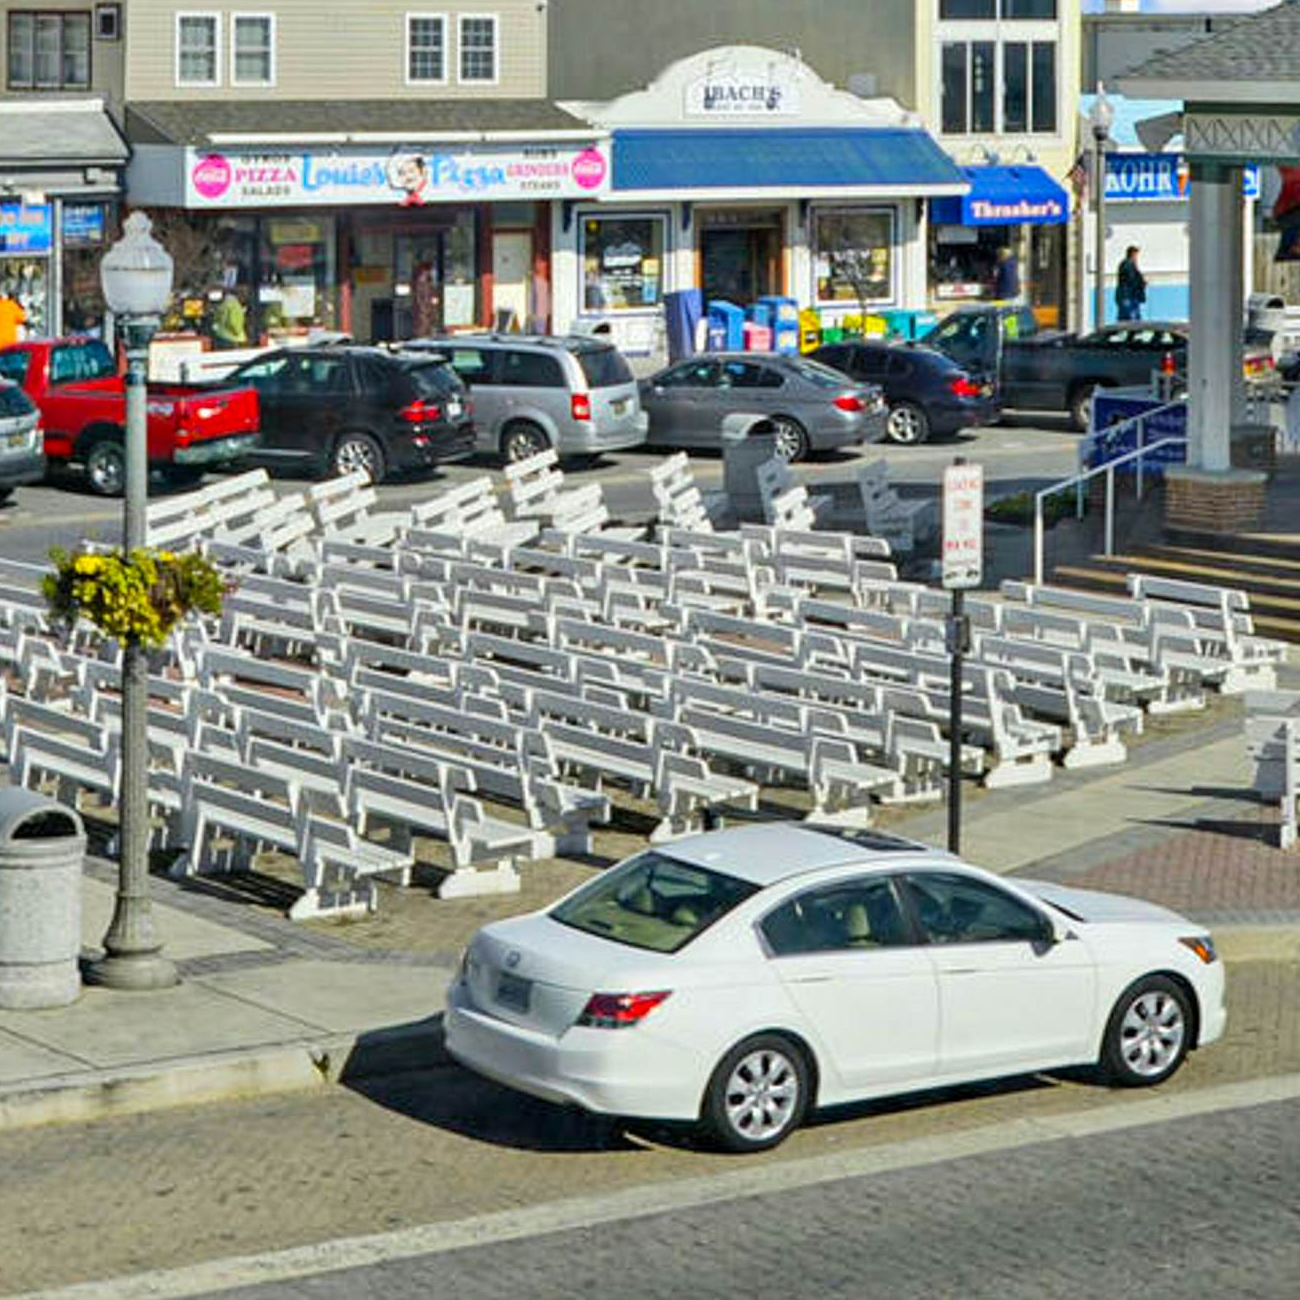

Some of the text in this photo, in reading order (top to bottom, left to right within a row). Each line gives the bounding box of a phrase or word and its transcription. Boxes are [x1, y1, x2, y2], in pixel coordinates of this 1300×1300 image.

[235, 167, 297, 183] PIZZA
[302, 152, 507, 192] Louie's Pizza
[1104, 159, 1172, 192] KOHR
[241, 186, 291, 197] SALADS
[519, 181, 561, 191] STEAKS
[971, 201, 1062, 221] Thrasher's
